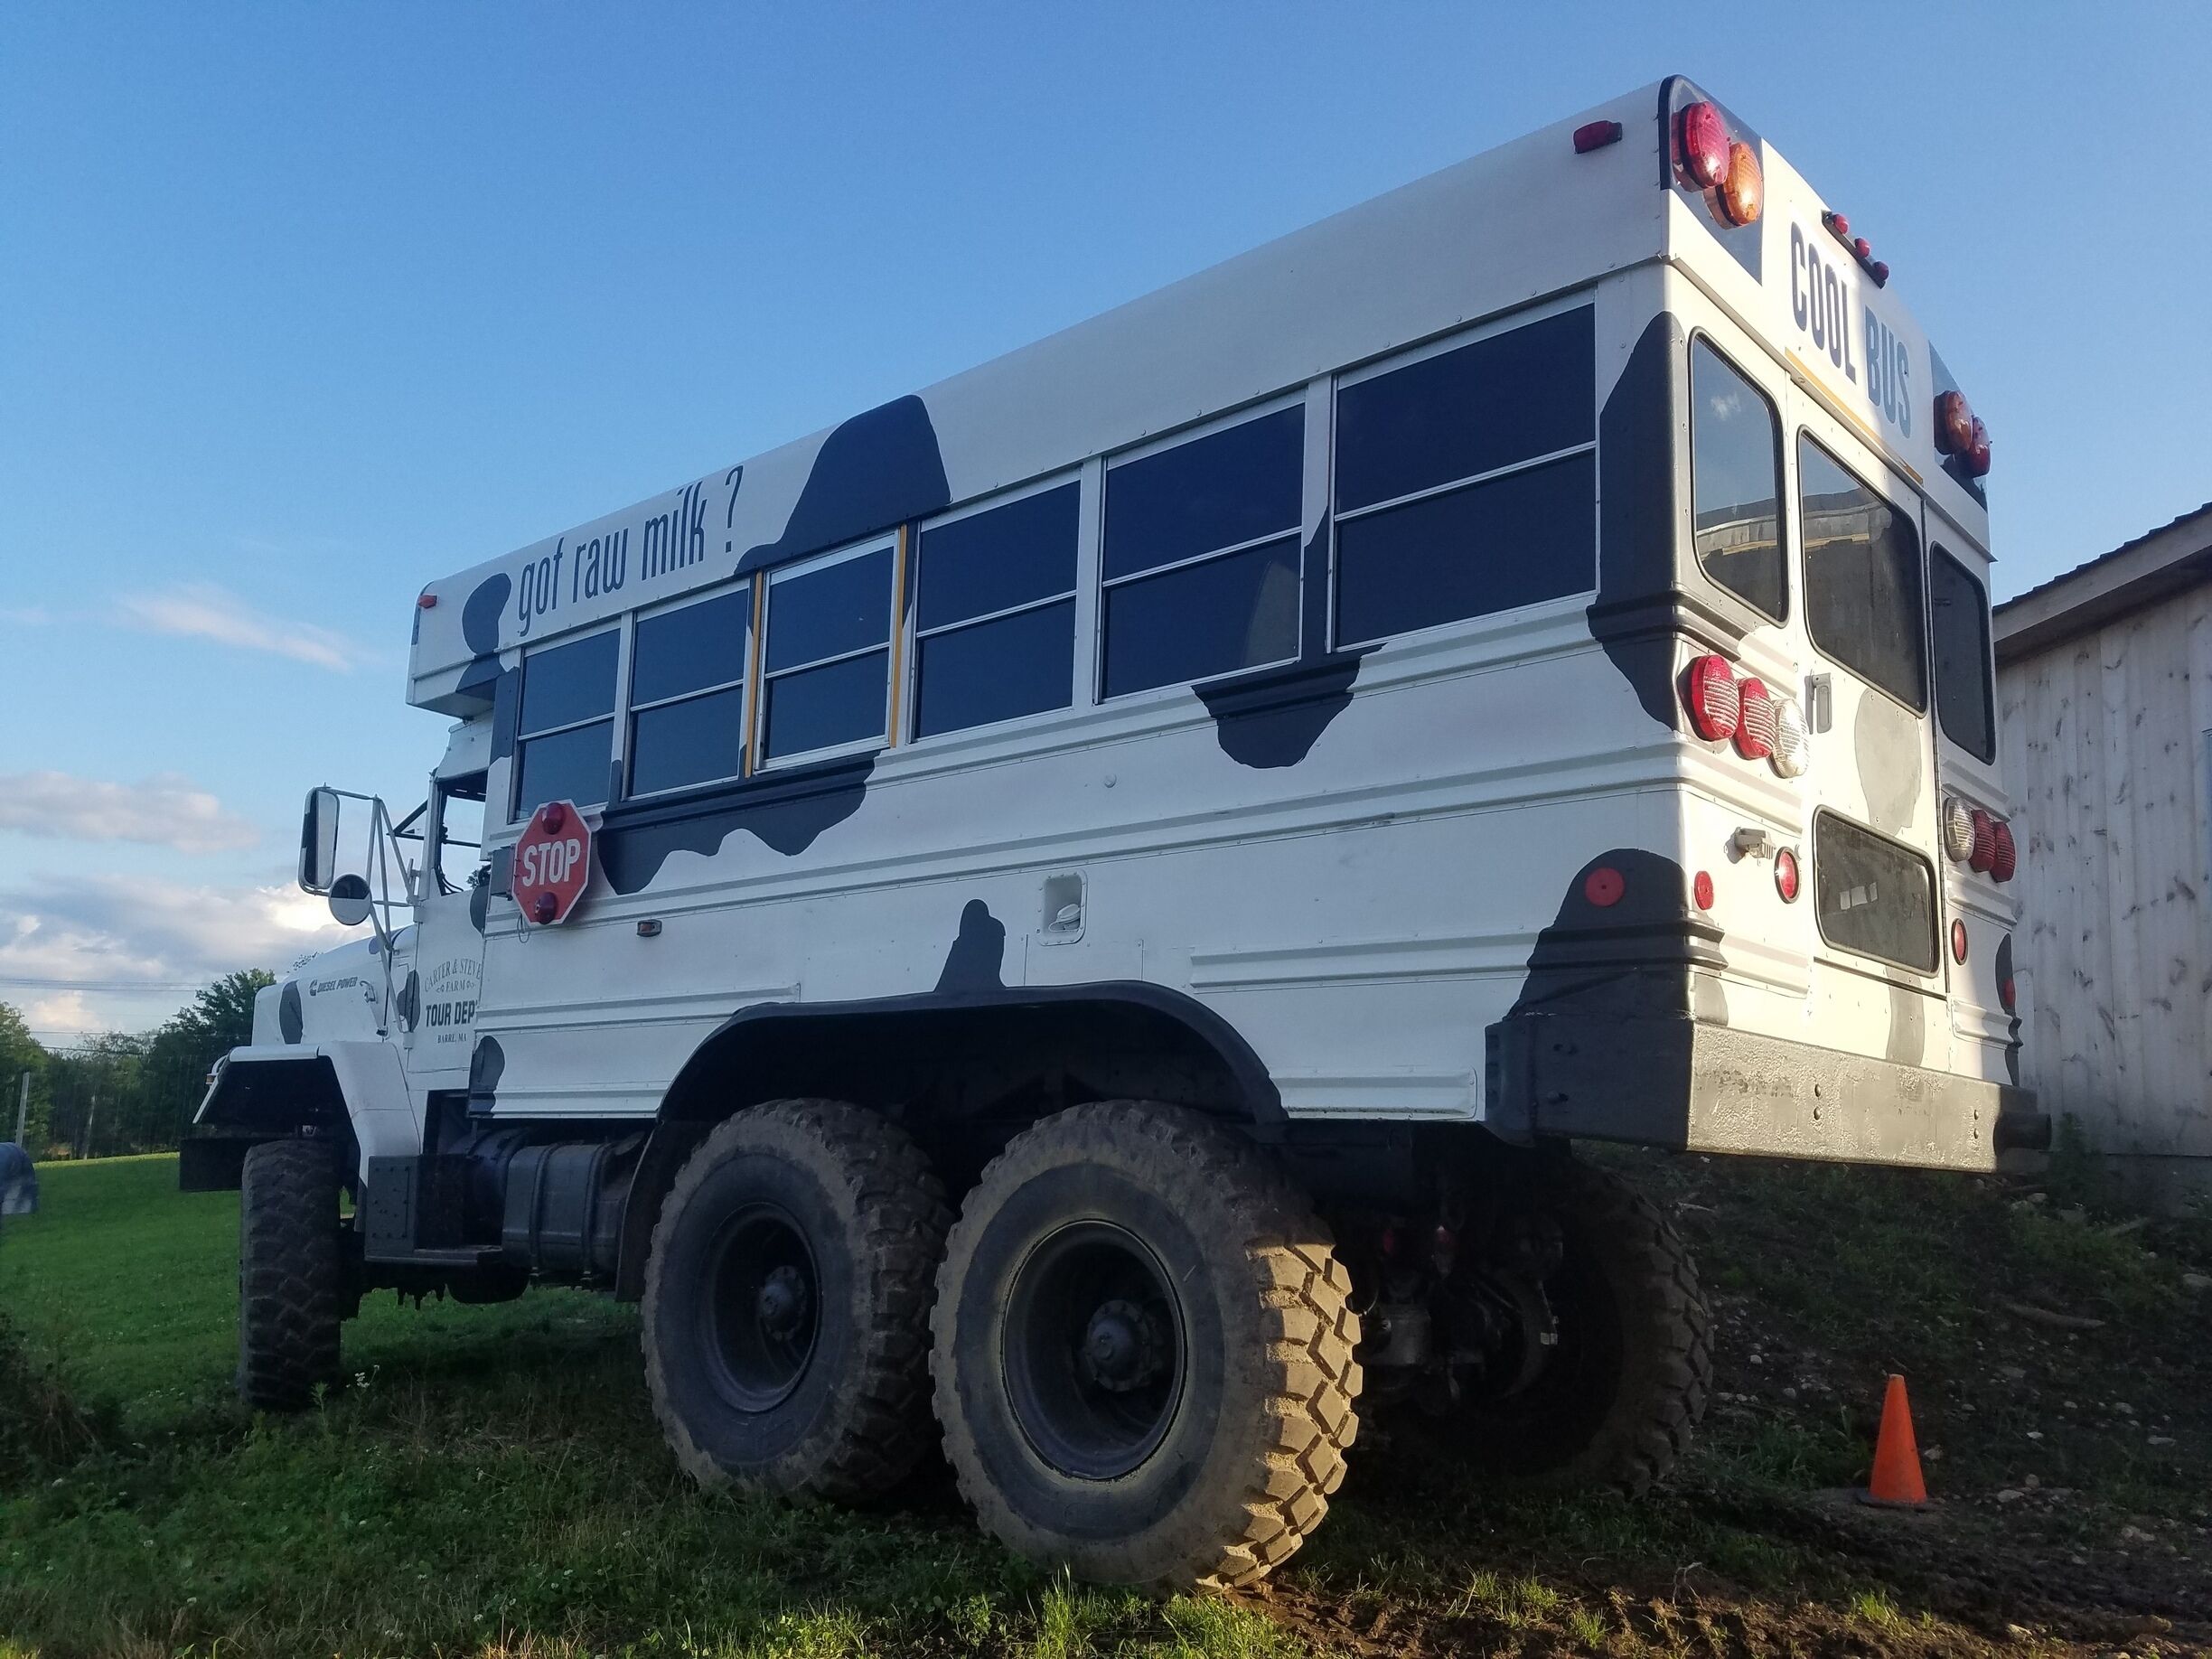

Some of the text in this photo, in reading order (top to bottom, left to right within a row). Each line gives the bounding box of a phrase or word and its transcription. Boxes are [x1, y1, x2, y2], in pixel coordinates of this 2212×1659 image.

[1791, 220, 1911, 439] COOL BUS
[518, 537, 564, 637] got
[572, 528, 629, 604] raw
[641, 481, 708, 581] milk
[522, 838, 581, 887] STOP
[317, 976, 358, 993] DIESEL POWER
[424, 961, 451, 992] CARTER
[445, 979, 465, 992] FARM
[426, 999, 478, 1027] TOUR DEP
